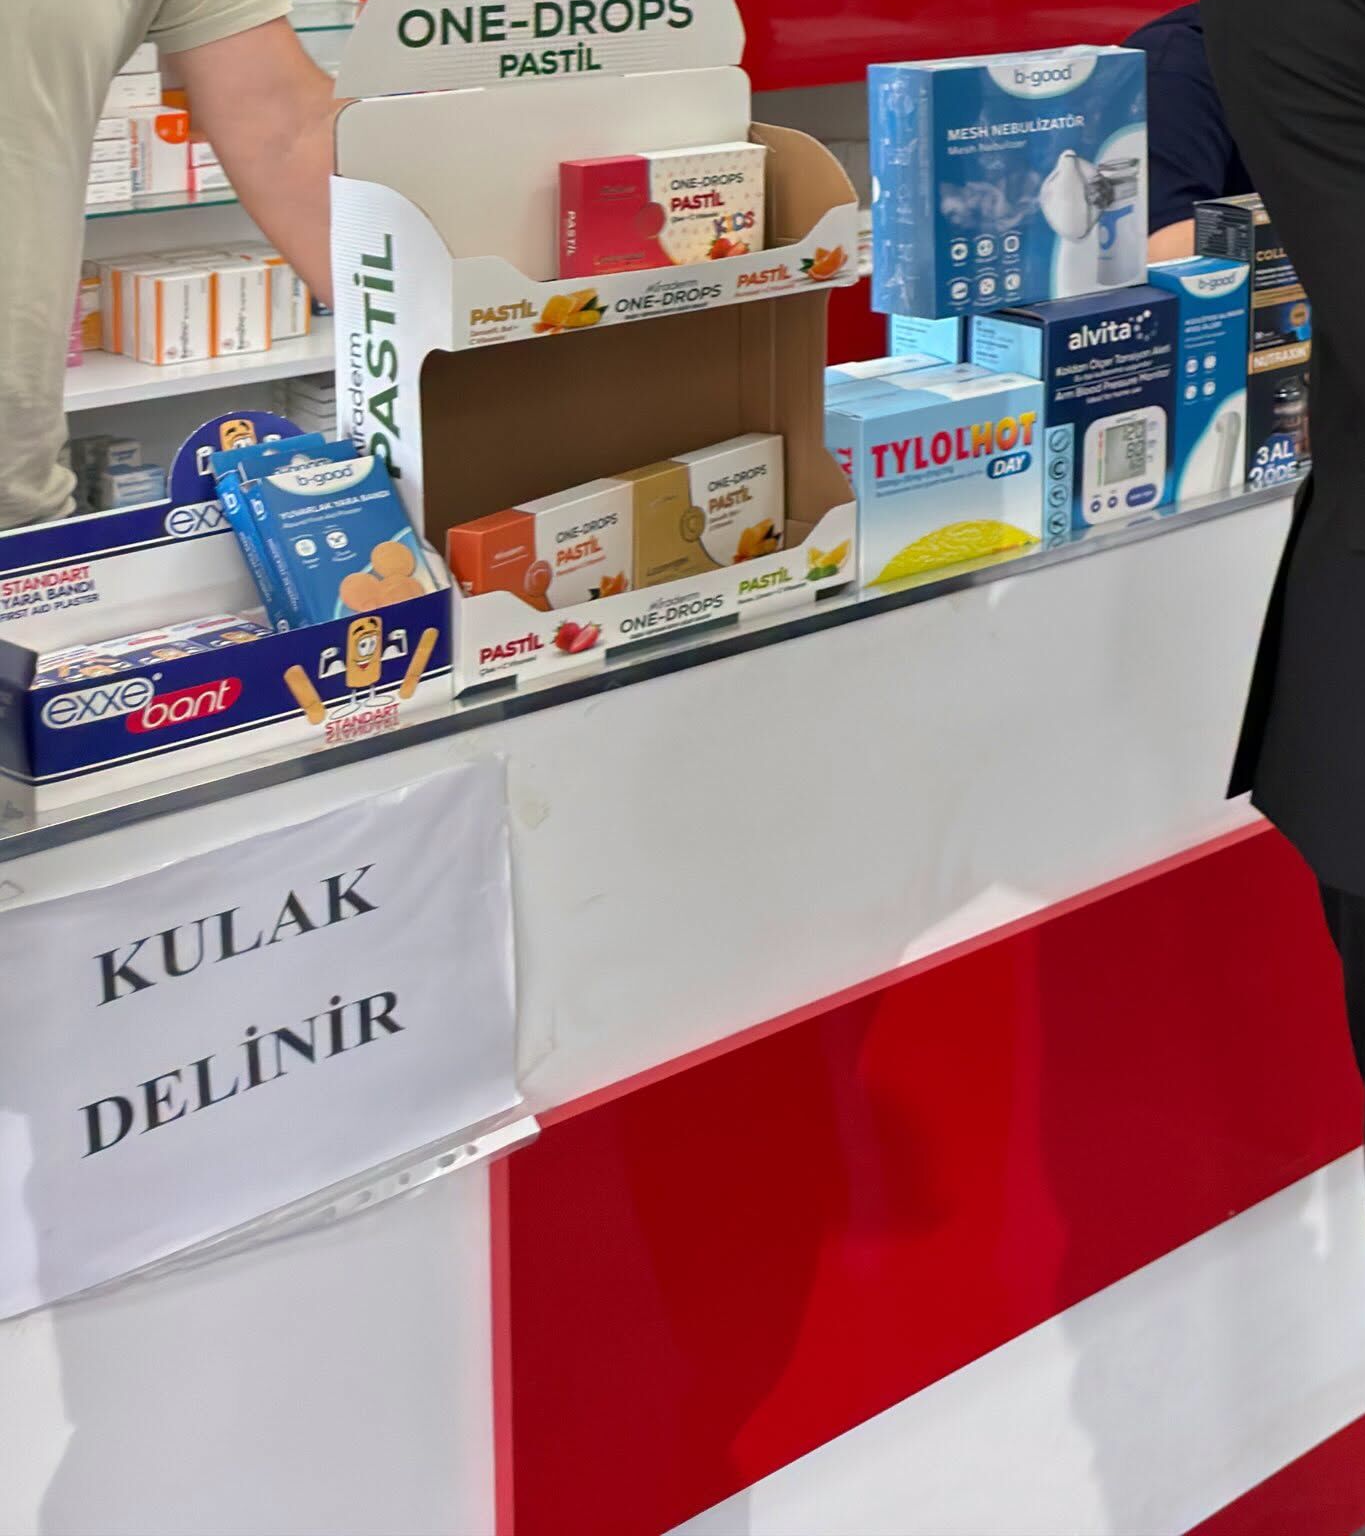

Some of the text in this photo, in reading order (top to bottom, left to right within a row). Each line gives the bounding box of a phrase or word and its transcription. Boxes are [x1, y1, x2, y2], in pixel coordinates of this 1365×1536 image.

[499, 41, 603, 78] PASTİL
[1014, 64, 1073, 88] b-good
[947, 127, 989, 142] MESH
[670, 172, 744, 191] ONE-DROPS
[670, 189, 725, 212] PASTİL
[713, 210, 755, 236] KIDS
[736, 264, 793, 289] PASTİL
[470, 298, 539, 326] PASTİL
[614, 284, 722, 314] ONE-DROPS
[1068, 319, 1133, 351] alvita
[354, 233, 402, 479] PASTİL
[992, 453, 1027, 476] DAY
[1256, 440, 1294, 465] 3 AL
[295, 463, 353, 487] b-good
[707, 463, 768, 492] ONE-DROPS
[708, 484, 753, 514] PASTİL
[555, 512, 618, 544] ONE-DROPS
[555, 532, 604, 566] PASTİL
[0, 578, 96, 610] YARA BANDI
[1, 565, 90, 596] STANDART
[738, 566, 793, 596] PASTİL
[31, 602, 51, 617] AID
[53, 592, 100, 613] PLASTER
[619, 594, 724, 635] ONE-DROPS
[479, 631, 545, 665] PASTİL
[46, 679, 232, 731] exxe bant
[324, 703, 401, 735] STANDART
[93, 862, 381, 1008] KULAK
[80, 987, 407, 1160] DELİNİR
